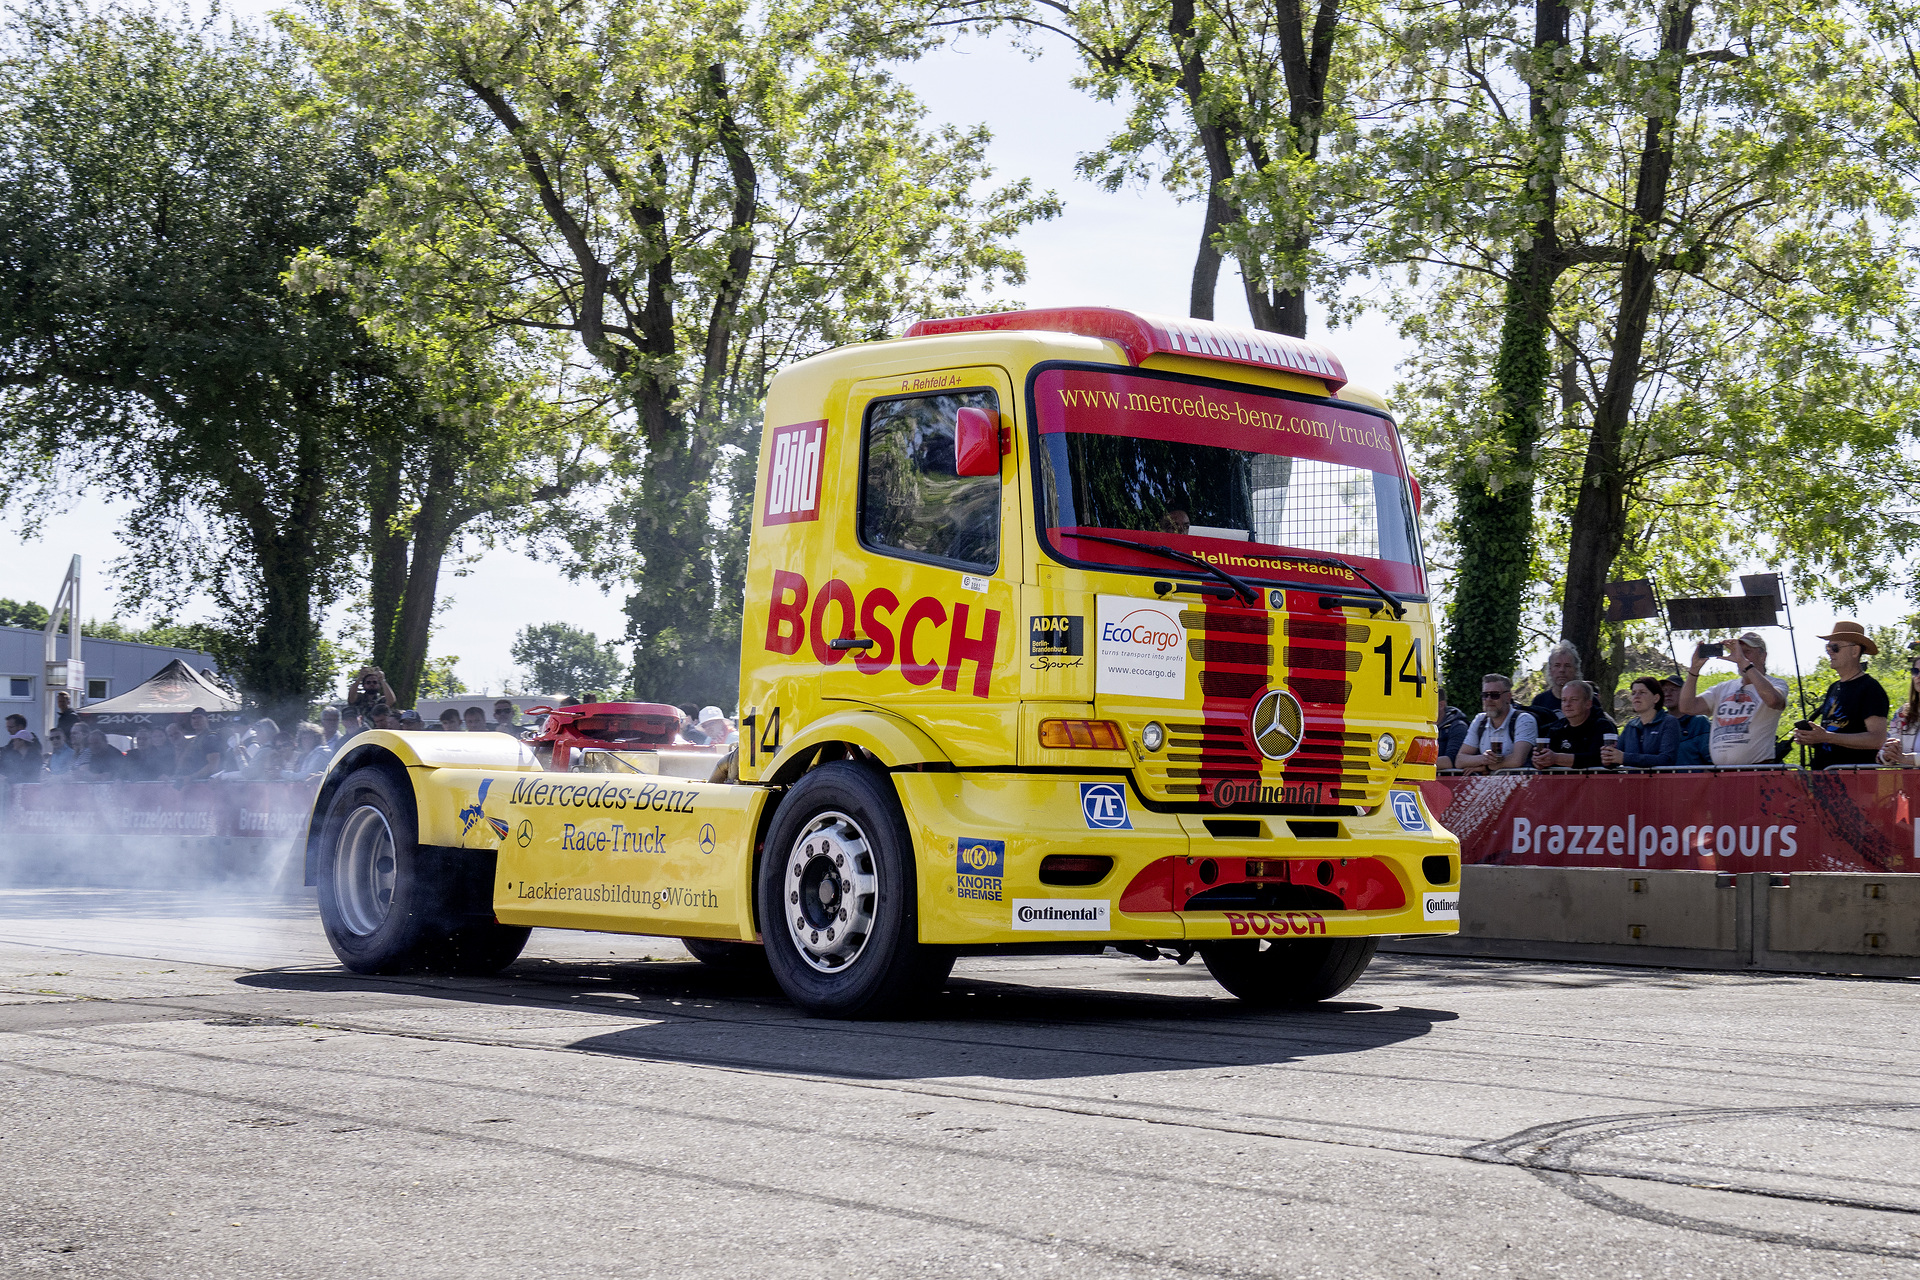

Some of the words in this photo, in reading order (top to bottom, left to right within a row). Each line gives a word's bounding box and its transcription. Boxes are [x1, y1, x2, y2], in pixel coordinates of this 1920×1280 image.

[1163, 321, 1337, 377] FERNFAHRER
[901, 380, 911, 392] R.
[913, 376, 948, 389] Rehfeld
[949, 375, 962, 386] A+
[1058, 388, 1393, 453] www.mercedes-benz.com/trucks
[769, 426, 823, 516] Bild
[1192, 550, 1355, 581] Hellmonds-Racing
[765, 569, 1001, 700] BOSCH
[1032, 617, 1069, 632] ADAC
[1102, 622, 1179, 652] EcoCargo
[1032, 640, 1050, 648] Berlin-
[1032, 645, 1068, 654] Brandenburg
[1121, 651, 1151, 660] transport
[1152, 652, 1165, 660] into
[1166, 654, 1184, 662] profit
[1030, 656, 1084, 672] Sport
[1108, 665, 1177, 679] www.ecocargo.de
[1373, 635, 1427, 698] 14
[97, 714, 153, 724] 24MX
[1717, 703, 1756, 716] Gulf
[743, 706, 783, 767] 14
[509, 777, 700, 814] Mercedes-Benz
[1213, 779, 1322, 808] Continental
[1085, 794, 1124, 820] ZF
[1394, 801, 1424, 824] ZF
[562, 823, 667, 854] Race-Truck
[1511, 814, 1798, 867] Brazzelparcours
[518, 881, 662, 909] Lackierausbildung
[667, 886, 719, 908] Wörth
[957, 875, 1002, 891] KNORR
[957, 888, 1003, 901] BREMSE
[1018, 905, 1098, 923] Continental
[1223, 911, 1327, 936] BOSCH
